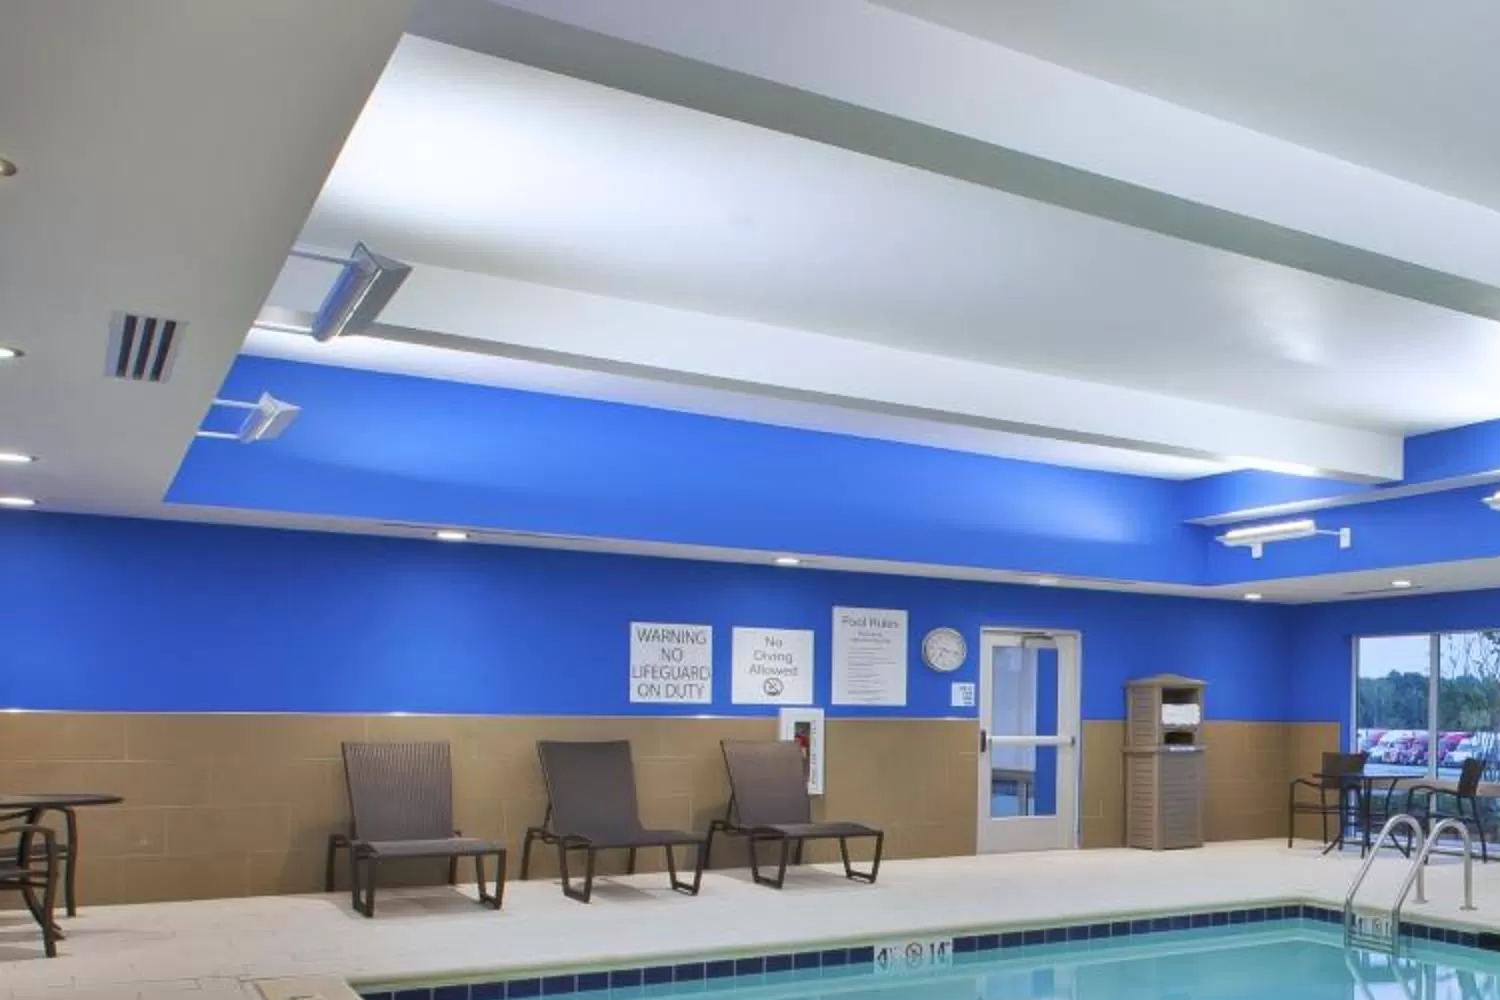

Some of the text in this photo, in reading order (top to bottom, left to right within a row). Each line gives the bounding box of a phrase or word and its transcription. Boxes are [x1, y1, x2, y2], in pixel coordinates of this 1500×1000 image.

[636, 627, 707, 645] WARNING
[764, 635, 783, 649] No
[660, 647, 684, 663] NO
[753, 649, 793, 665] Diving
[631, 664, 710, 681] LIFEGUARD
[749, 662, 799, 677] Allowed
[637, 682, 705, 699] ON DUTY
